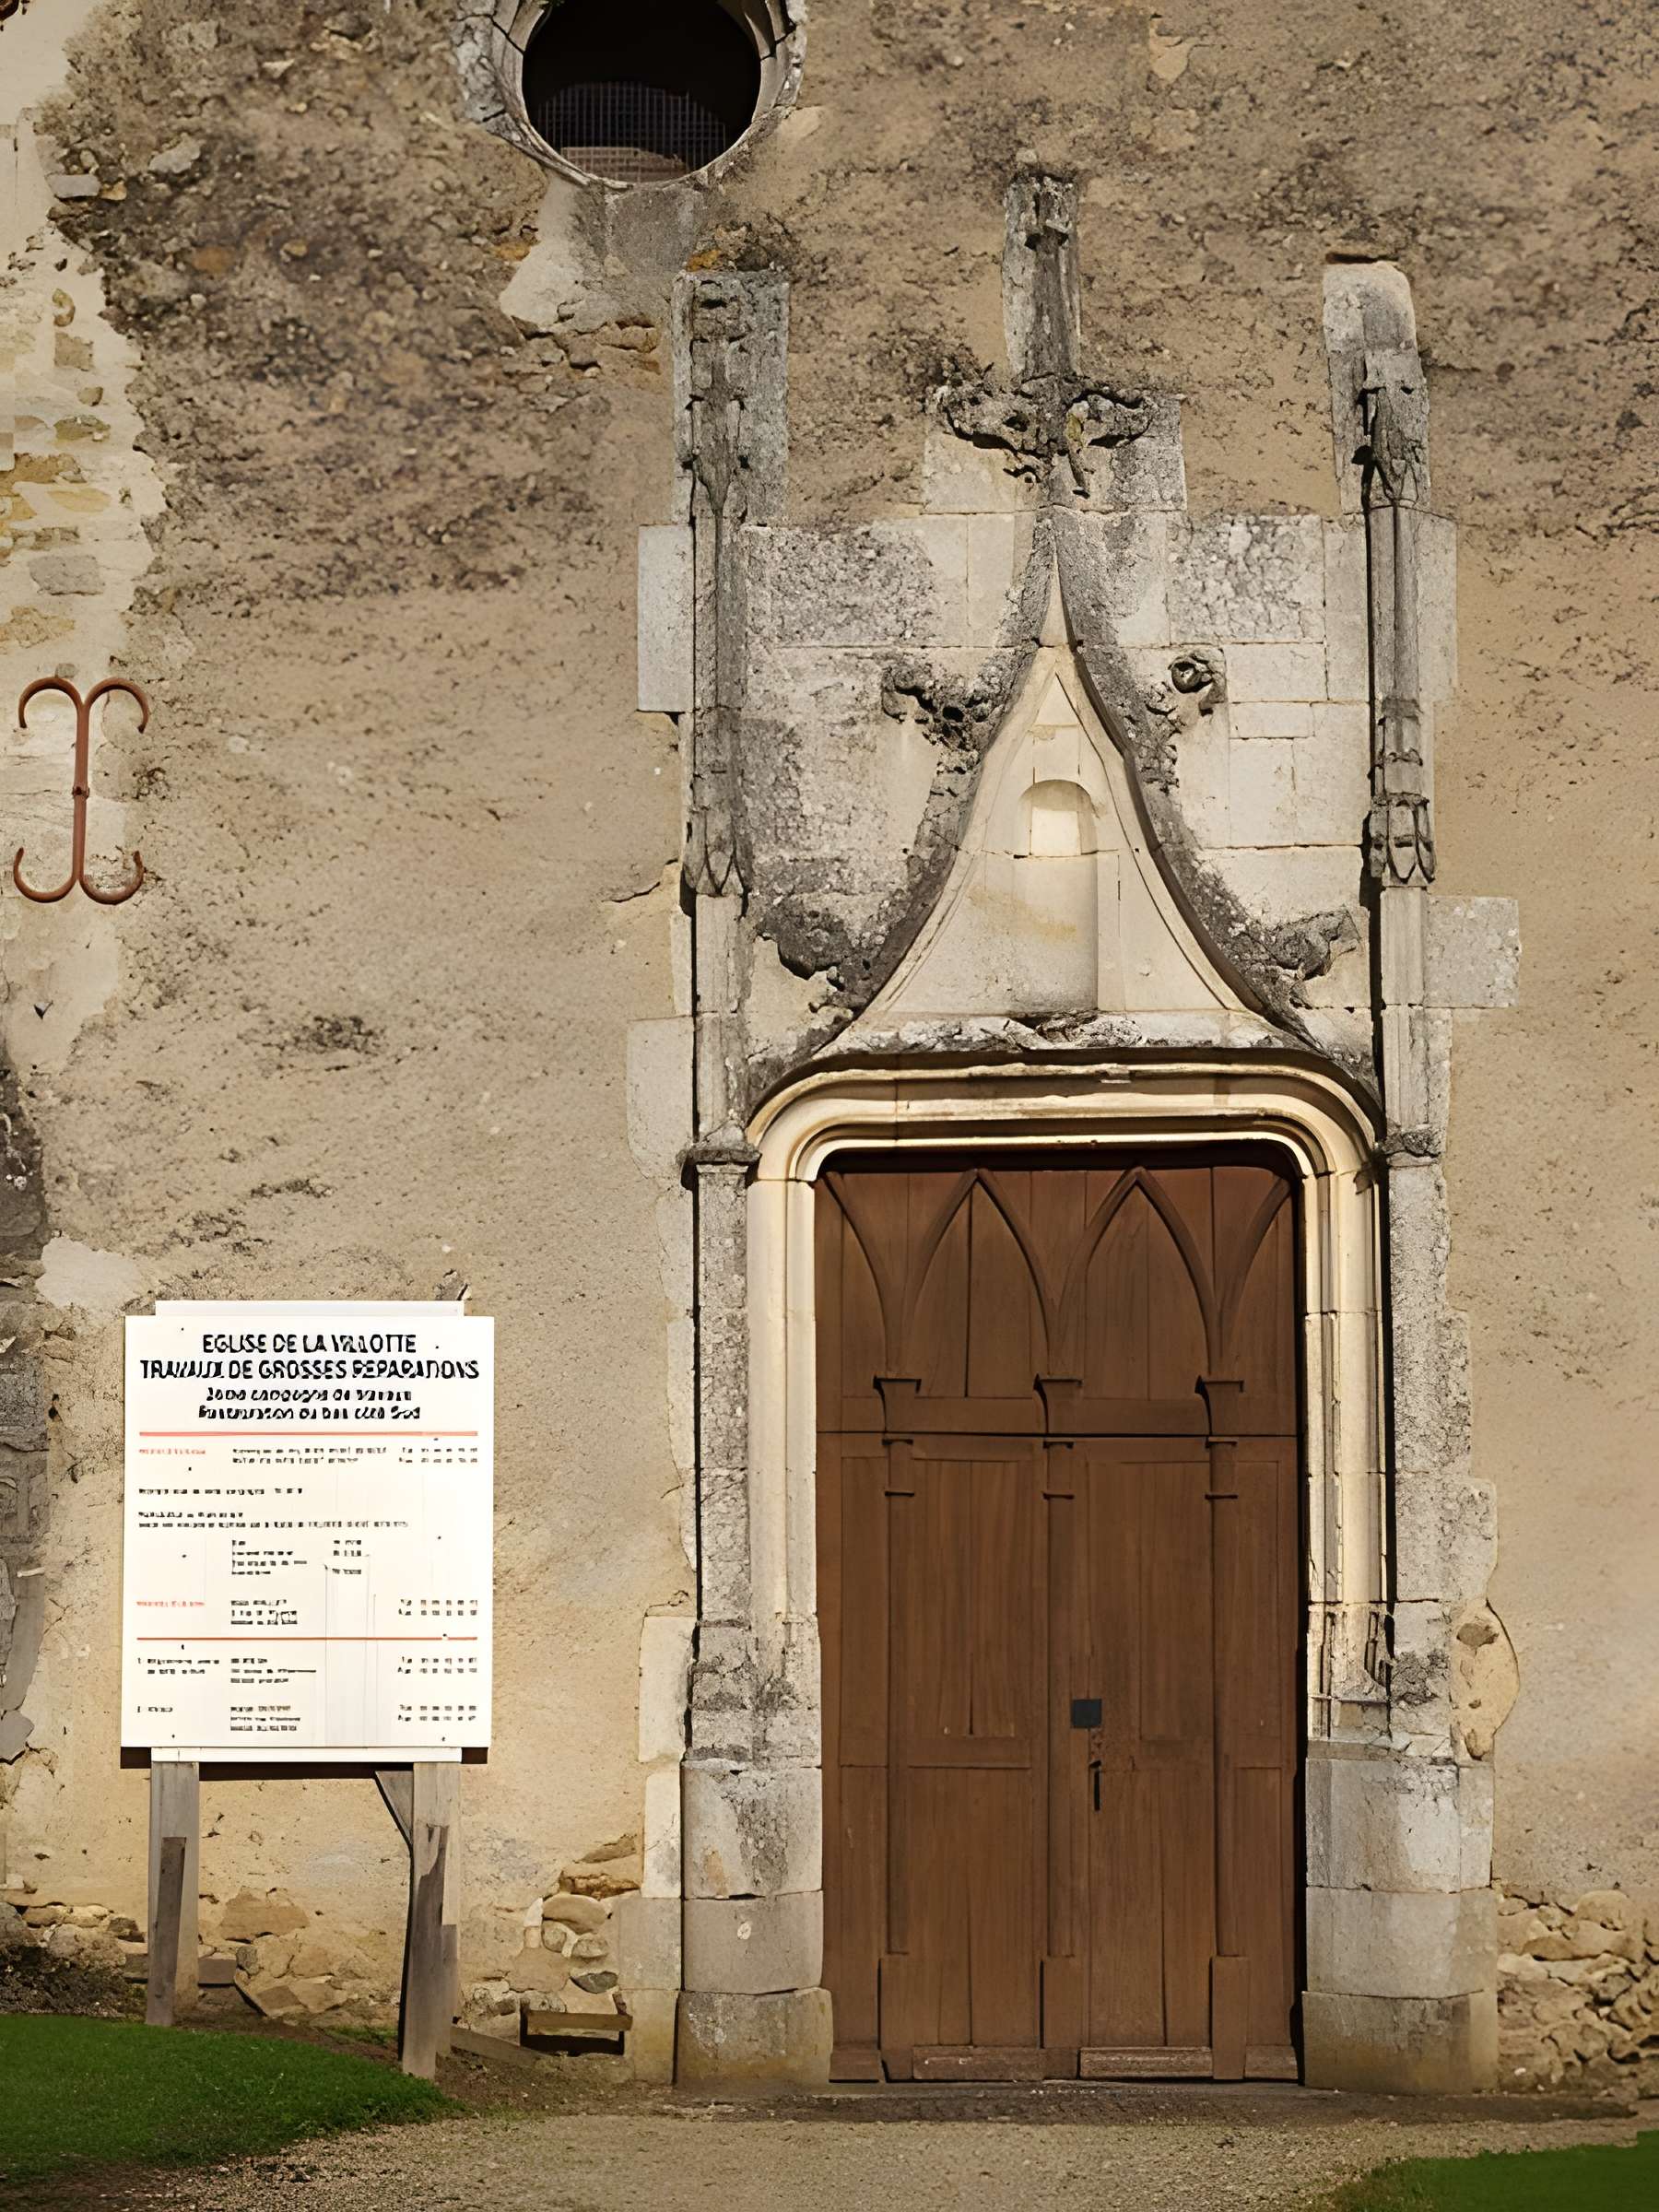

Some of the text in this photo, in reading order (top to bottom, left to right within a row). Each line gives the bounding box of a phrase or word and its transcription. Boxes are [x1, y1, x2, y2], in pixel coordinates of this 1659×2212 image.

[272, 1333, 298, 1354] DE
[302, 1333, 328, 1354] LA
[228, 1359, 253, 1381] DE
[257, 1359, 347, 1381] GROSSES
